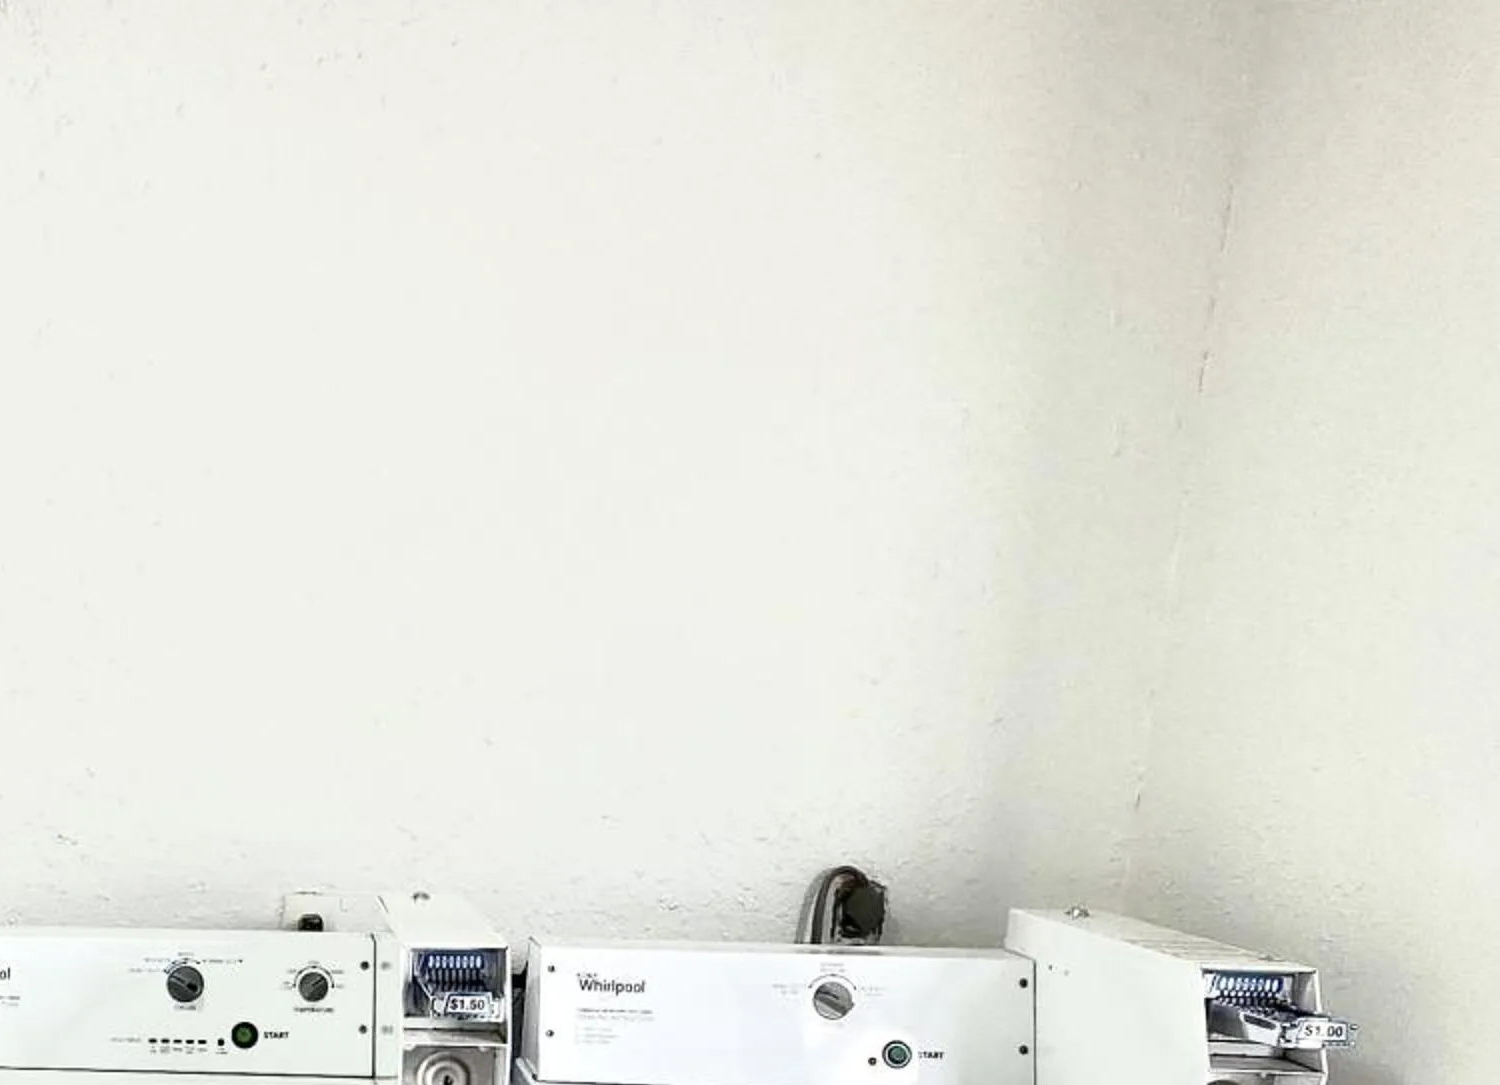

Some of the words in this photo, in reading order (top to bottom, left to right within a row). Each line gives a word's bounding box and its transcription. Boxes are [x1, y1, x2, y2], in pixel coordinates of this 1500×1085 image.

[579, 978, 646, 996] Whirlpool
[450, 998, 485, 1010] $1.50
[263, 1031, 289, 1039] START
